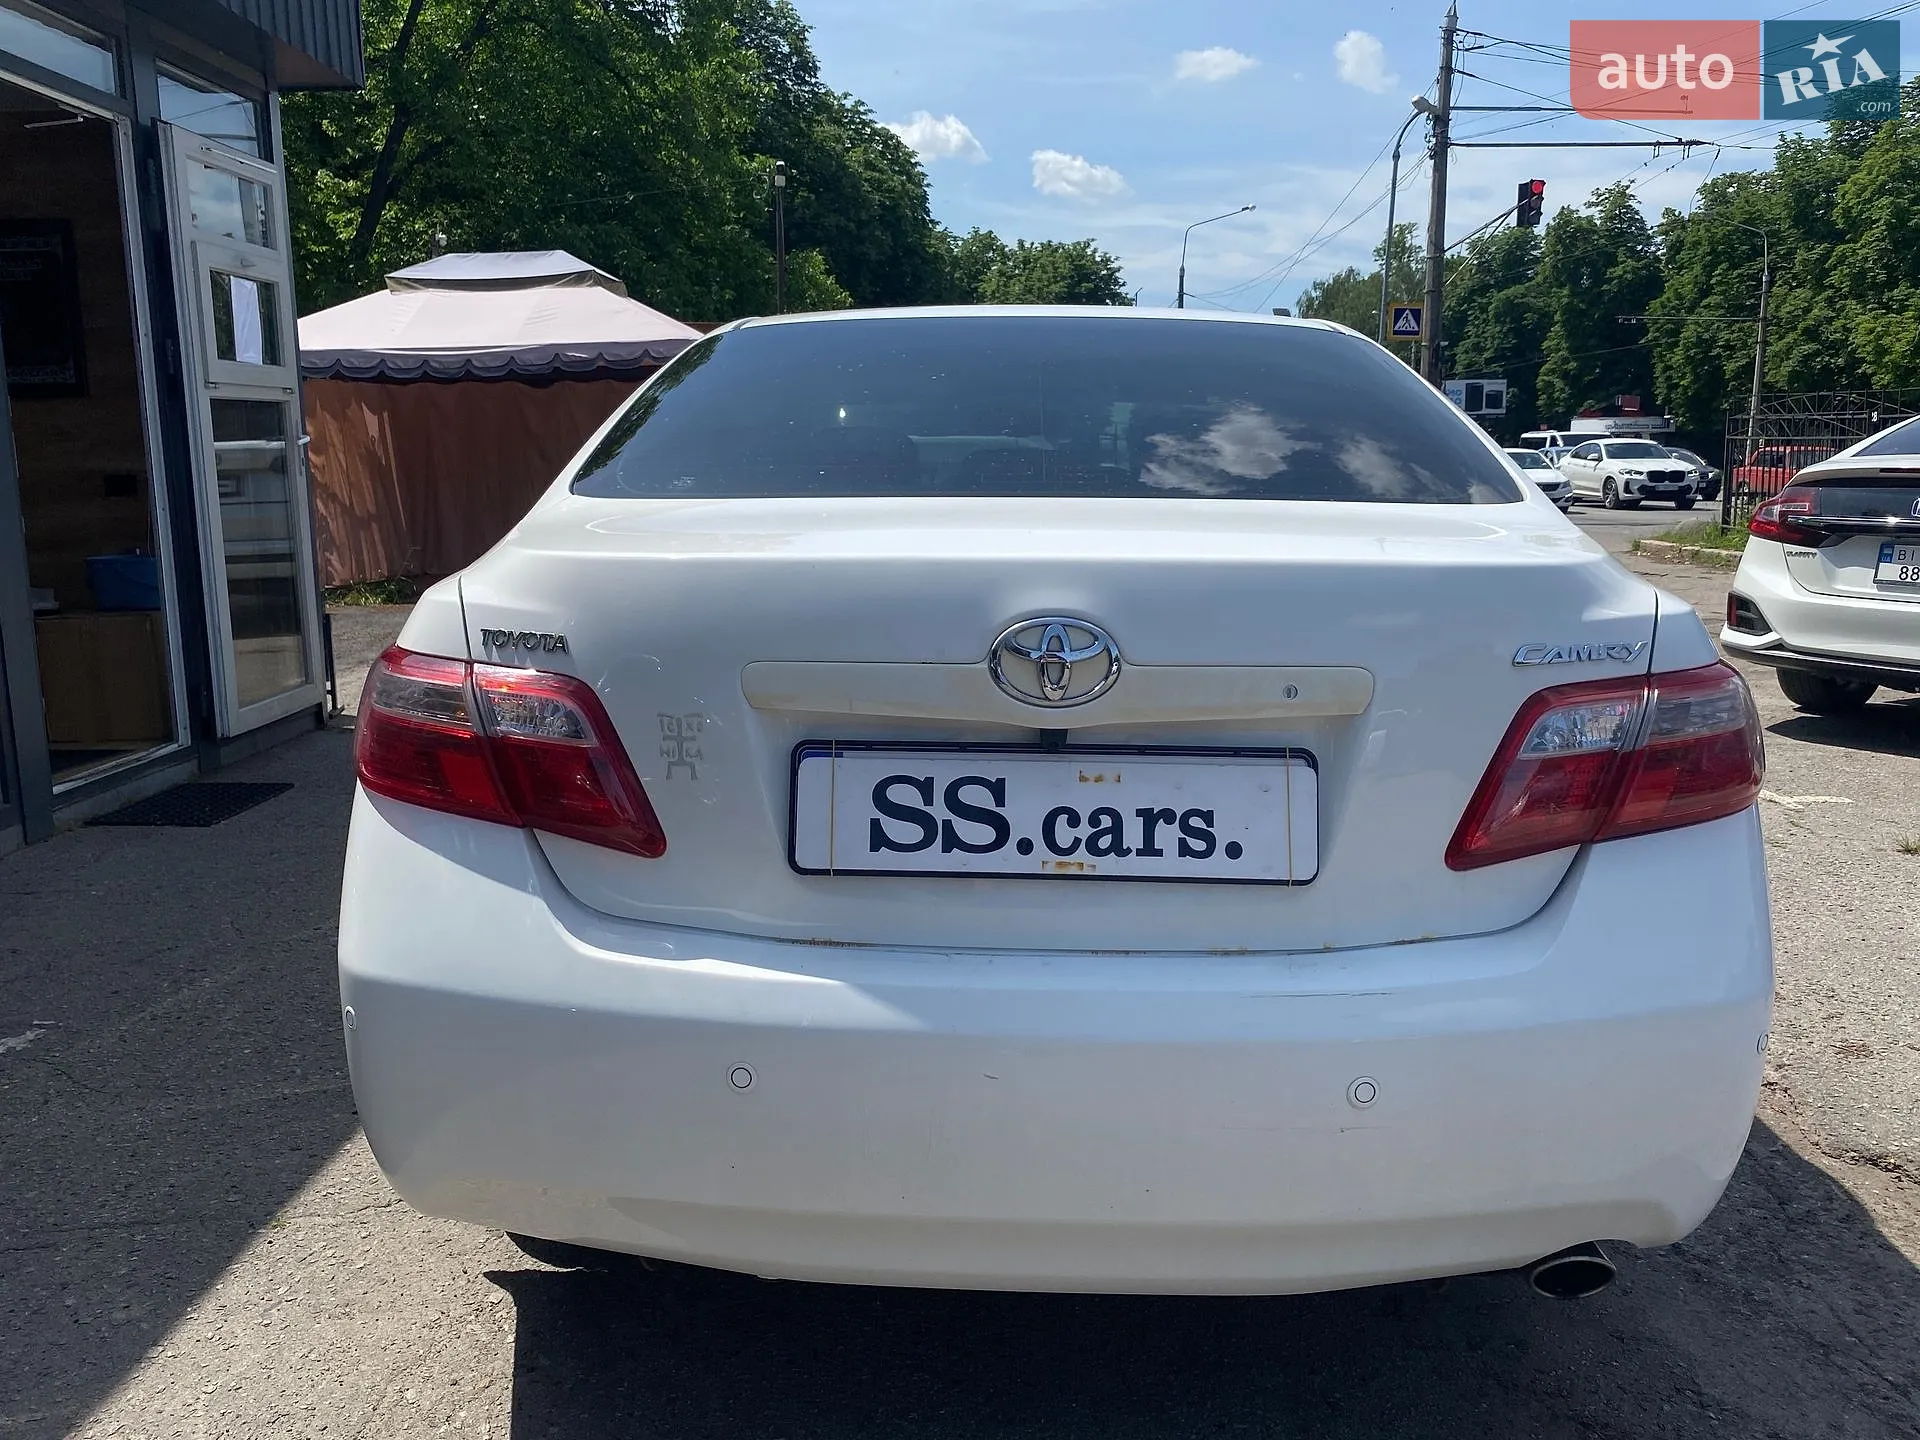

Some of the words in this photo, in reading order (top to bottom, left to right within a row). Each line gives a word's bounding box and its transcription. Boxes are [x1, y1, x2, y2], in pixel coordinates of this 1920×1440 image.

[1897, 549, 1915, 561] BI
[1898, 566, 1920, 581] 88
[480, 627, 568, 654] TOYOTA
[1512, 640, 1648, 667] CAMRY
[868, 774, 1243, 860] SS.cars.
